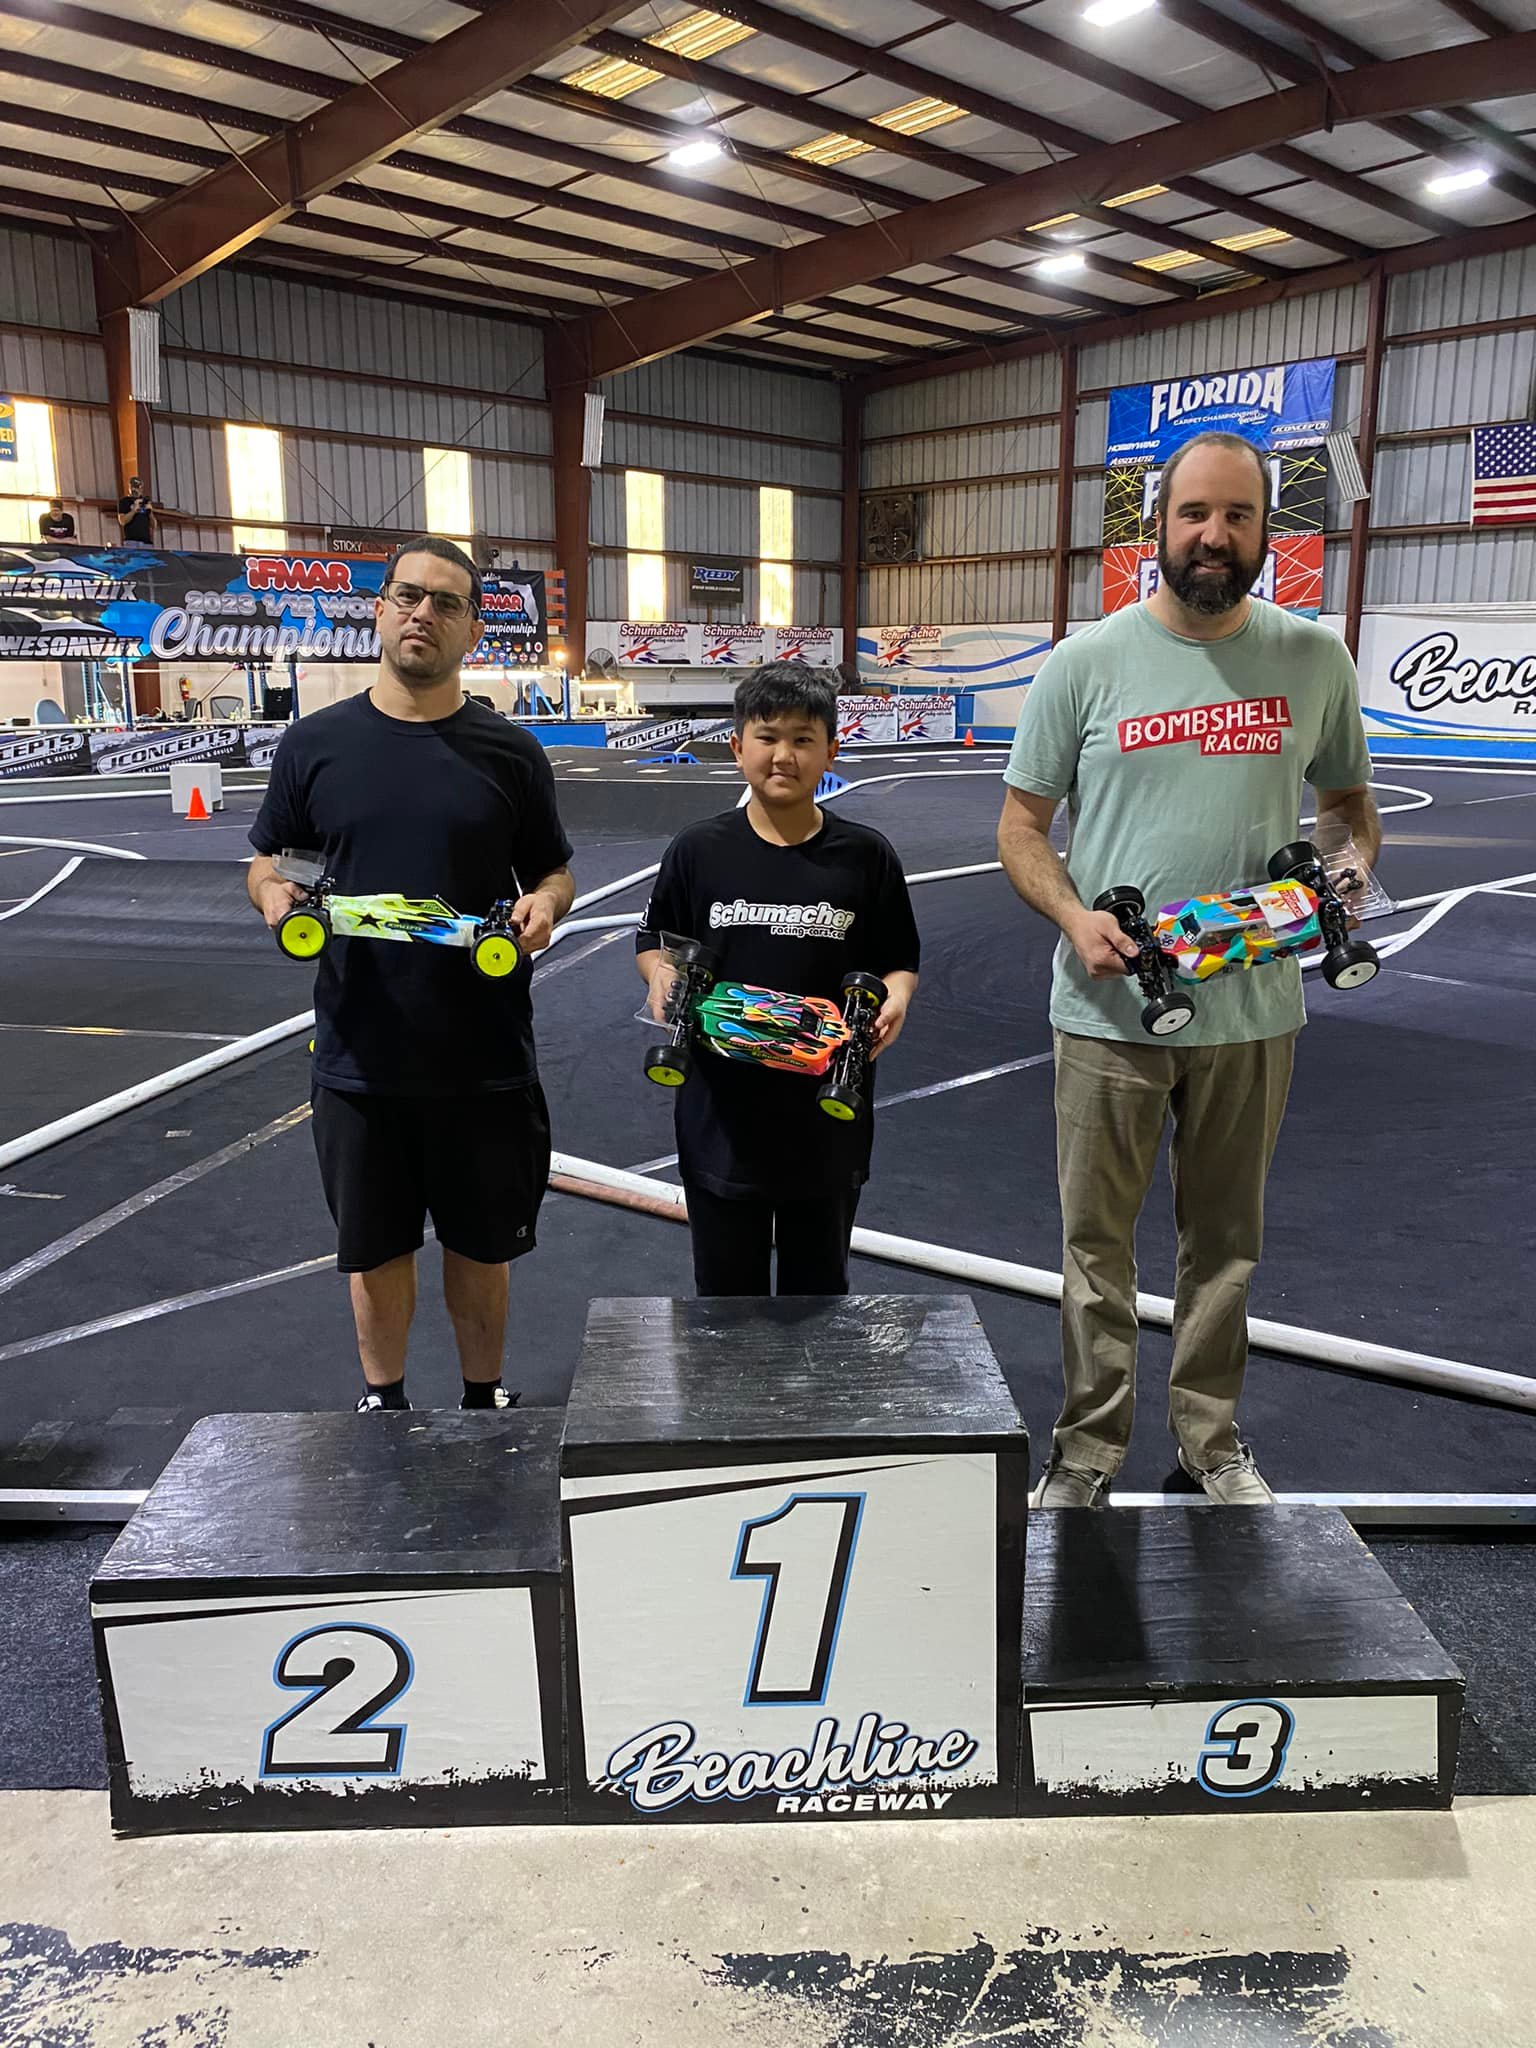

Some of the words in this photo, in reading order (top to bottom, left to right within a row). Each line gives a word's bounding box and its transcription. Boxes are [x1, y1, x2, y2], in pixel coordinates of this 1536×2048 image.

[1150, 367, 1286, 433] FLORIDA
[1173, 417, 1201, 426] CARPET
[246, 557, 352, 593] iFMAR
[692, 566, 740, 583] REEDY
[185, 591, 257, 616] 2023
[263, 593, 316, 618] 1/12
[620, 623, 688, 638] Schumacher
[703, 624, 765, 638] Schumacher
[776, 626, 833, 640] Schumacher
[881, 628, 941, 640] Schumacher
[838, 700, 896, 713] Schumacher
[899, 700, 954, 711] Schumacher
[613, 720, 690, 749] JCONCEPTS
[1125, 700, 1289, 748] BOMBSHELL
[104, 729, 233, 770] JCONCEPTS
[213, 747, 234, 756] design
[1204, 733, 1279, 752] RACING
[54, 752, 78, 762] design
[709, 899, 855, 930] Schumacher
[729, 1491, 867, 1707] 1
[259, 1622, 415, 1778] 2
[1197, 1698, 1296, 1798] 3
[607, 1712, 979, 1812] Beachline
[776, 1793, 953, 1814] RACEWAY
